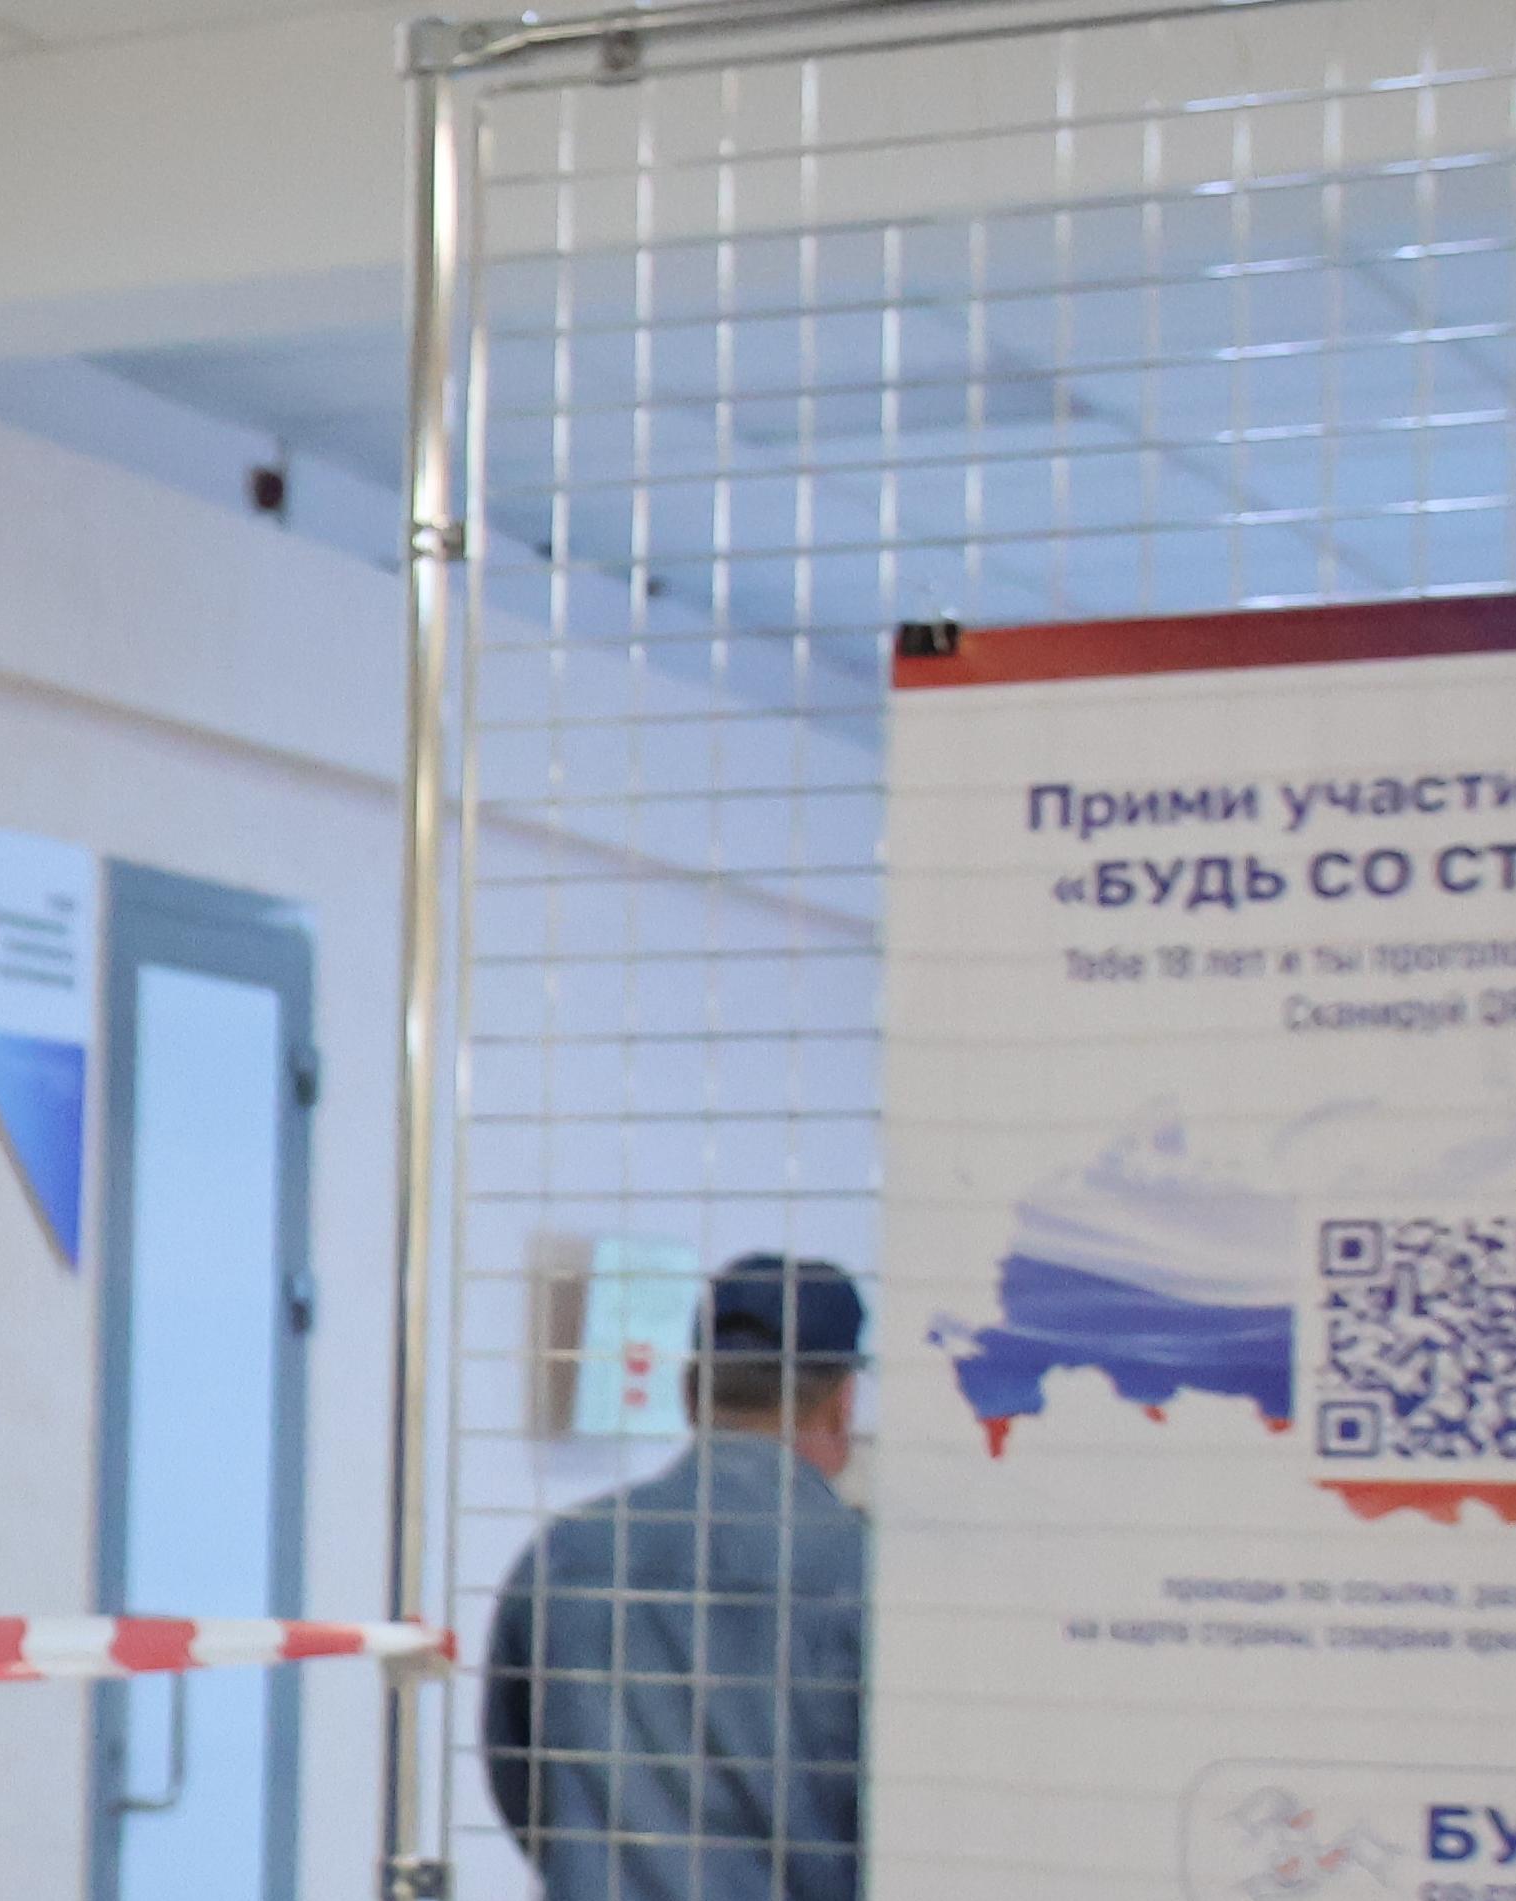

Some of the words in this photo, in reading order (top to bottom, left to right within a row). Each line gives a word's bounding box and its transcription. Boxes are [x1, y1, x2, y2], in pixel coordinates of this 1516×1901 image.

[1026, 781, 1259, 842] Прими
[1053, 854, 1288, 911] «БУДЬ
[1308, 848, 1414, 901] СО
